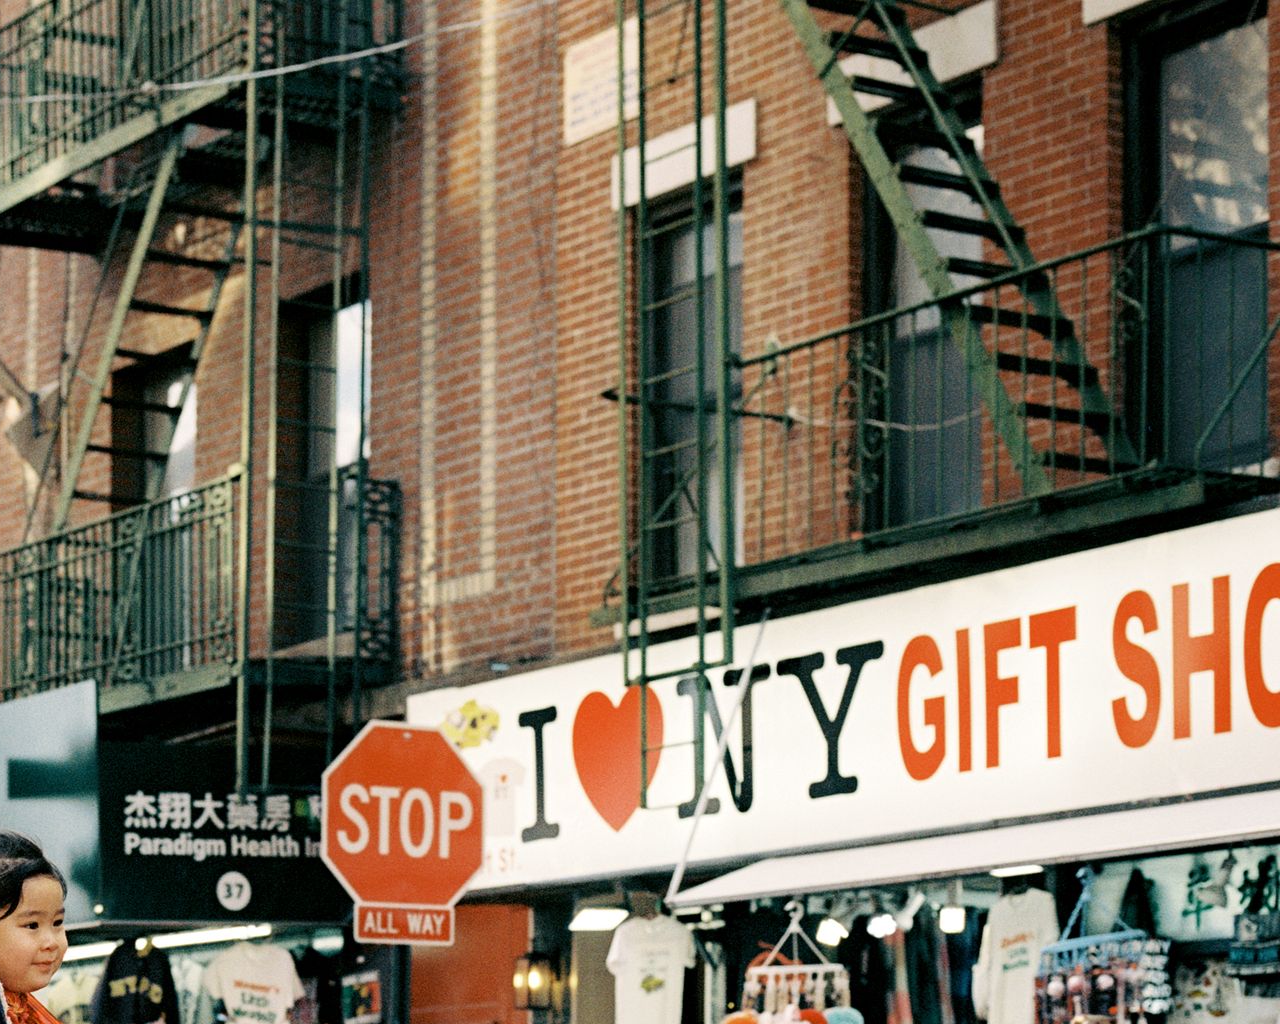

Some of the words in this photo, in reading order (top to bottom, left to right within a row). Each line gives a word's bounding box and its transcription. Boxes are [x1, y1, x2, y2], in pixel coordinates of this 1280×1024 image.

[897, 605, 1077, 781] GIFT
[518, 705, 560, 843] I
[676, 640, 884, 819] NY
[123, 832, 227, 862] Paradigm
[231, 833, 301, 858] Health
[336, 783, 474, 859] STOP
[223, 883, 244, 899] 37
[363, 911, 400, 933] ALL
[405, 912, 446, 935] WAY
